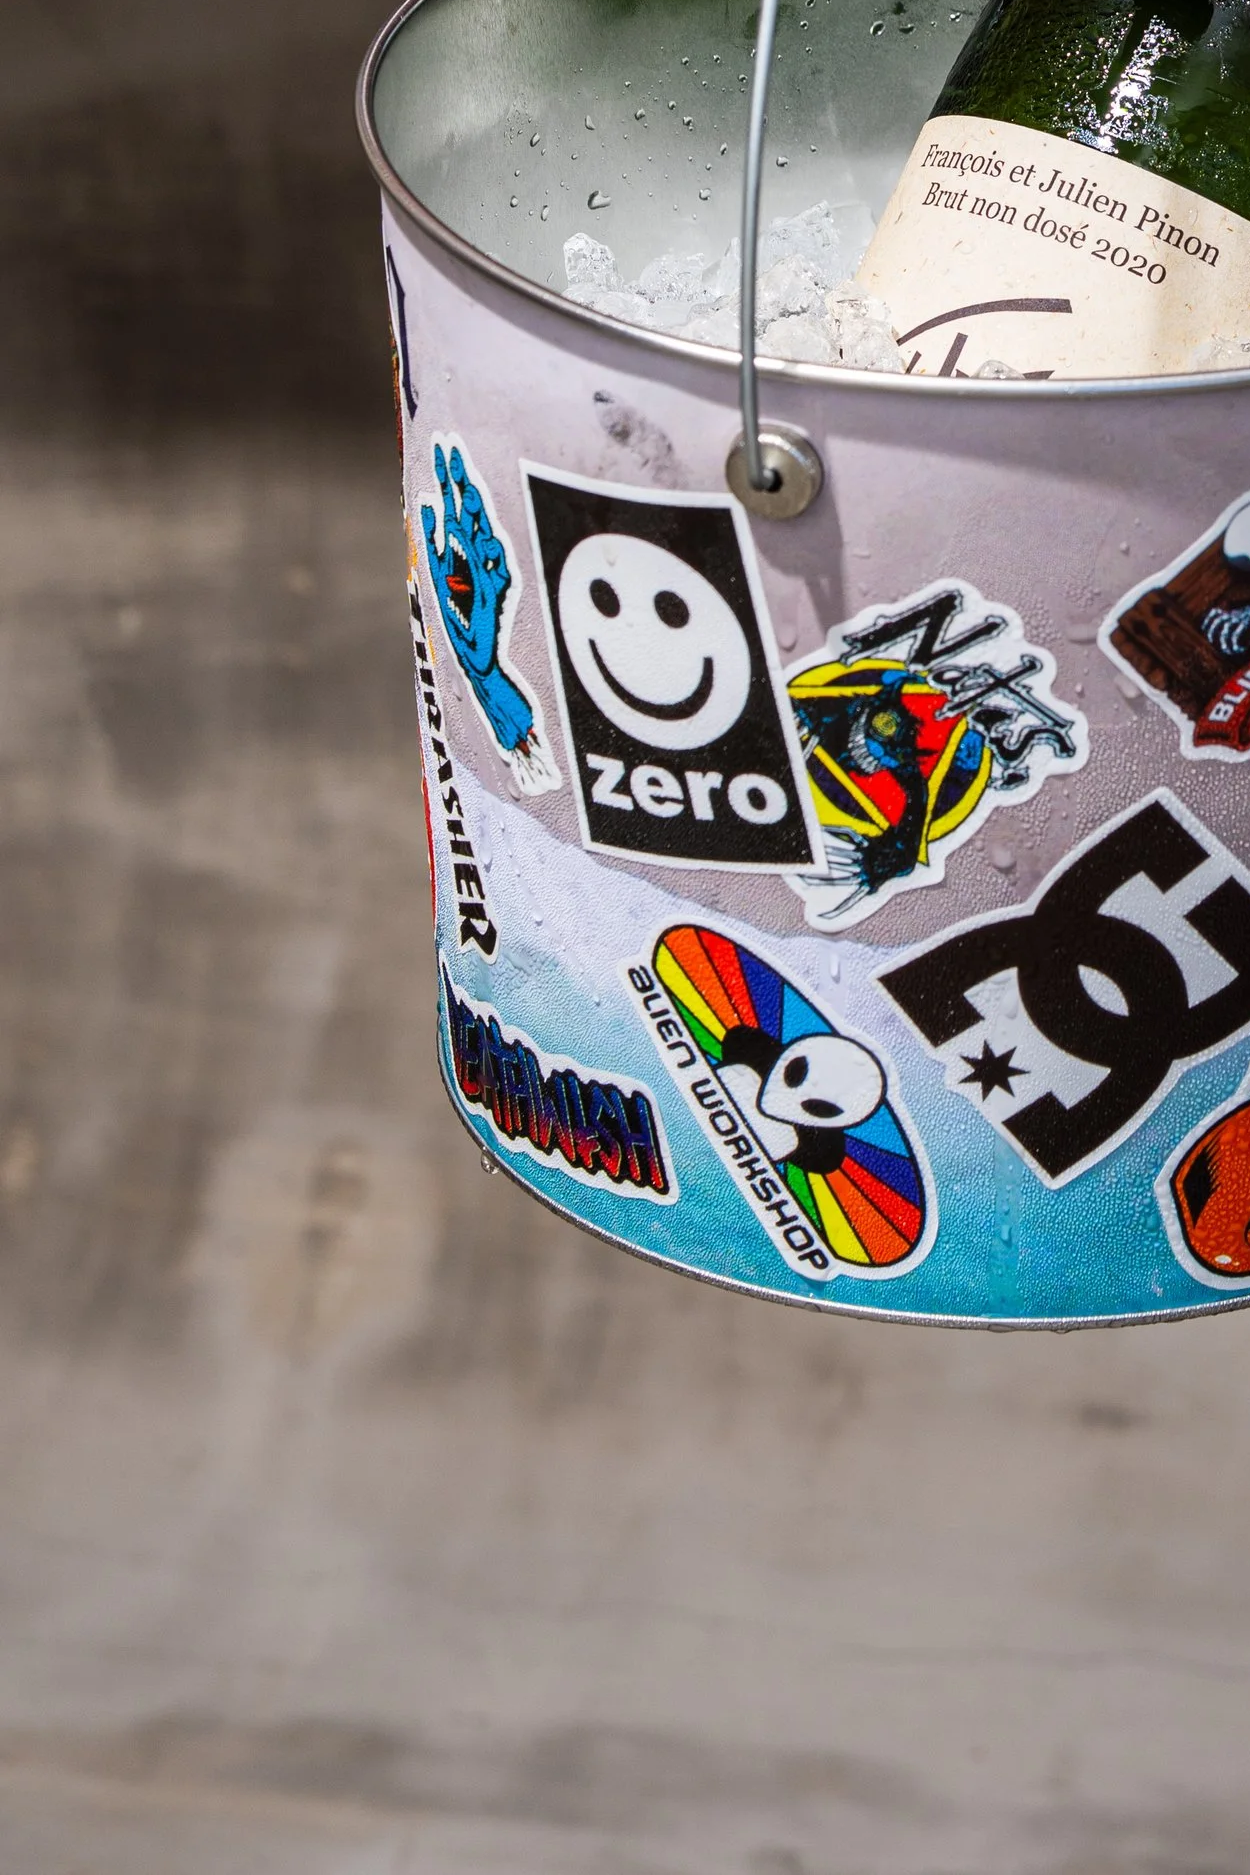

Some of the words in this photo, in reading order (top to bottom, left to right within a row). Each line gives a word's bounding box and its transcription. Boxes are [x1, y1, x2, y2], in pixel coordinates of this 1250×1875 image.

[921, 143, 1005, 178] François
[1009, 162, 1037, 186] et
[1038, 169, 1129, 222] Julien
[1134, 204, 1221, 268] Pinon
[921, 181, 969, 211] Brut
[968, 196, 1017, 226] non
[1023, 206, 1088, 250] dosé
[1090, 237, 1168, 286] 2020
[585, 752, 789, 826] zero
[691, 1078, 830, 1272] WORKSHOP
